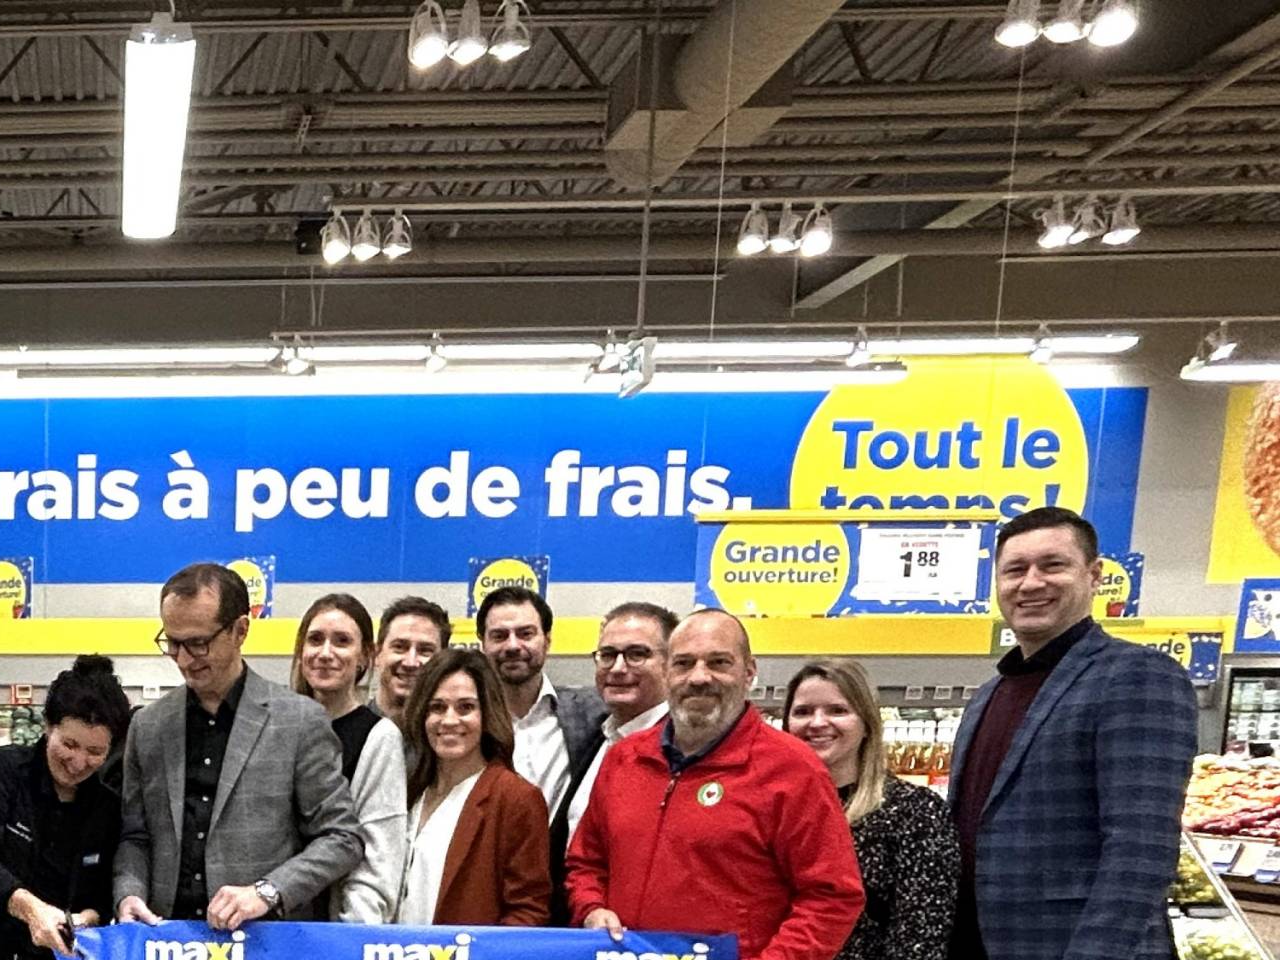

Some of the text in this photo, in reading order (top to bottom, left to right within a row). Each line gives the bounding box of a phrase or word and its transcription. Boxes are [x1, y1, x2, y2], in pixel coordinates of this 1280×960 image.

[832, 417, 1060, 469] Tout le
[162, 449, 210, 520] à
[235, 467, 390, 533] peu
[414, 450, 521, 519] de
[544, 449, 753, 518] frais.
[725, 540, 841, 563] Grande
[480, 574, 535, 588] Grande
[724, 568, 838, 583] ouverture!
